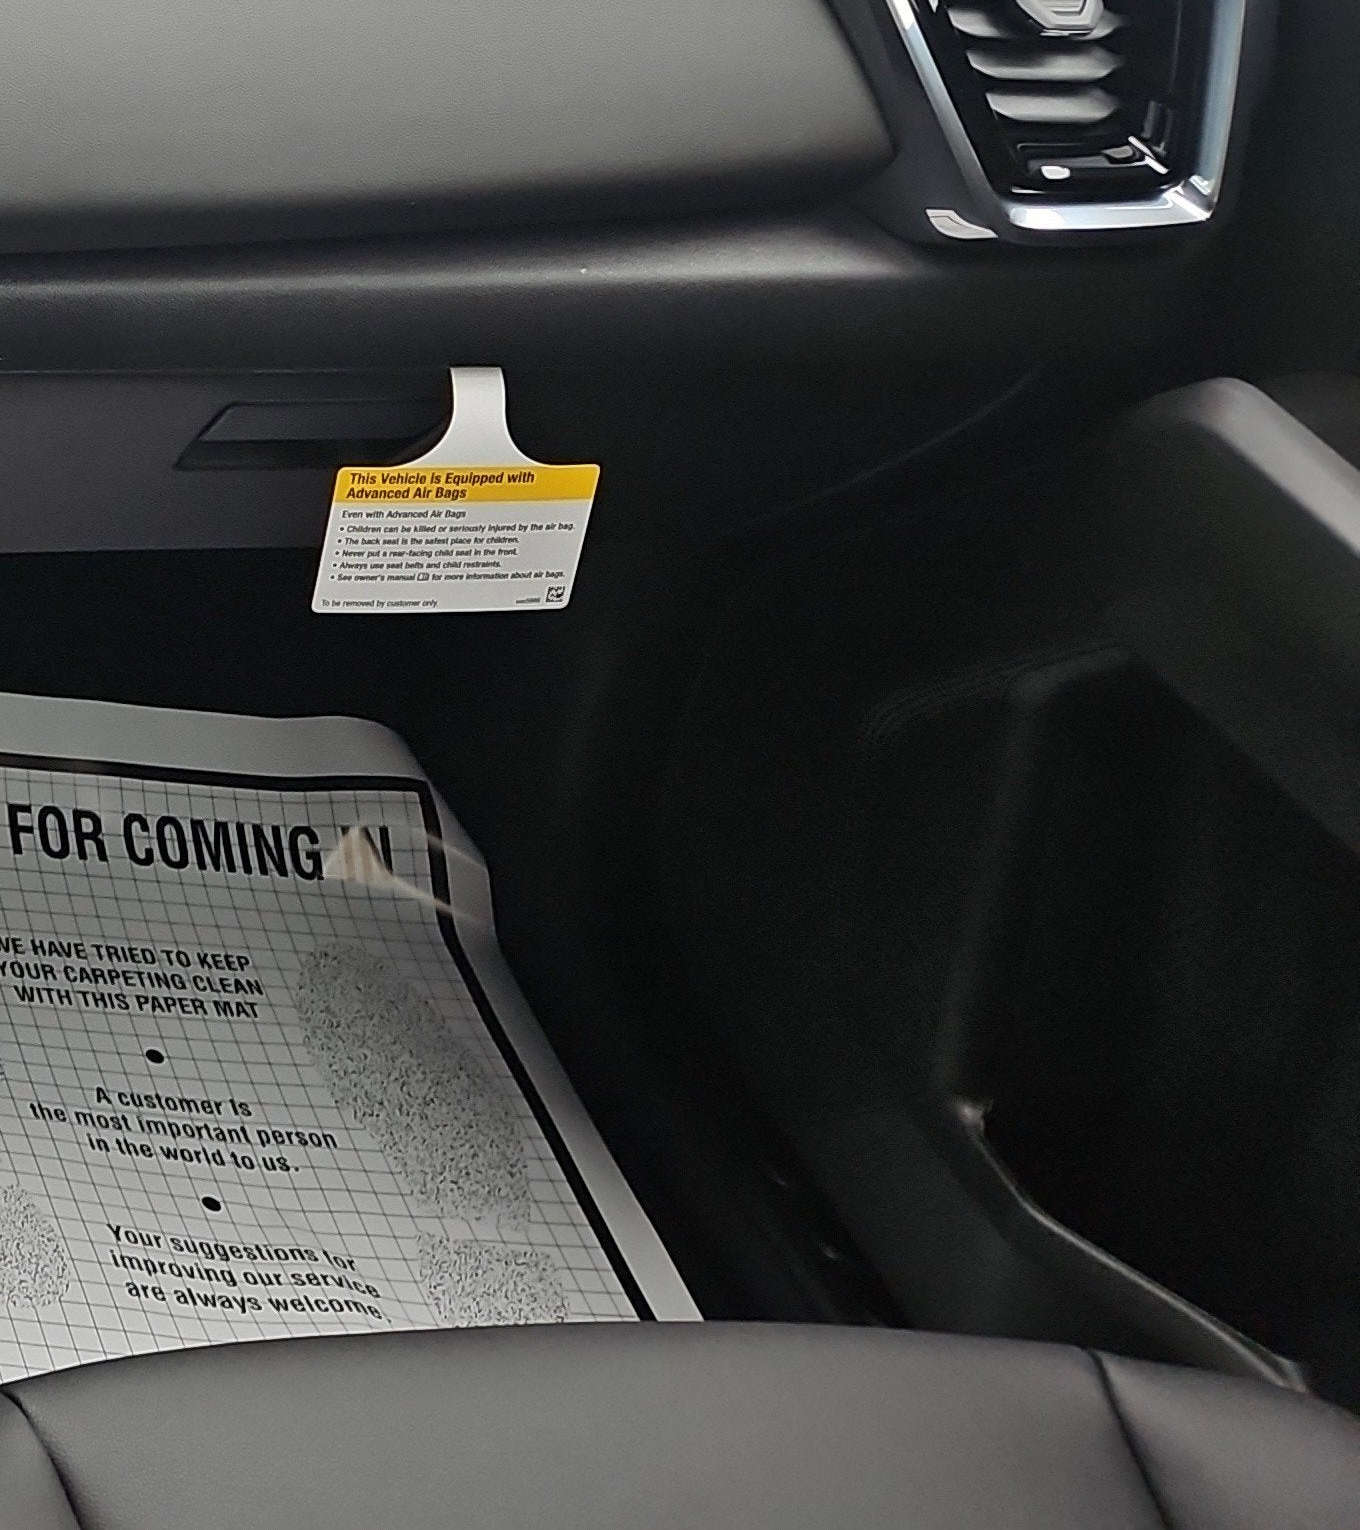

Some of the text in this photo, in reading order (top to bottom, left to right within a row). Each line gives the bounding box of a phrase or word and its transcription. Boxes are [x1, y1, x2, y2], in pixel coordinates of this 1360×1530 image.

[346, 486, 467, 501] Advanced Air Bags
[350, 472, 376, 484] This
[381, 472, 426, 485] Vehicle
[445, 472, 504, 487] Equipped
[508, 471, 534, 483] with
[342, 510, 466, 520] Even with Advanced Air Bags
[347, 525, 381, 533] Children
[401, 525, 411, 533] be
[414, 525, 436, 533] killed
[449, 525, 485, 533] seriously
[488, 524, 516, 533] injured
[519, 524, 528, 532] by
[531, 523, 543, 531] the
[345, 537, 359, 545] The
[361, 537, 380, 545] back
[383, 537, 399, 545] seat
[425, 537, 449, 545] safest
[450, 537, 471, 545] place
[7, 802, 109, 862] FOR
[122, 812, 324, 880] COMING
[30, 940, 88, 960] HAVE
[91, 944, 156, 965] TRIED
[161, 950, 191, 968] TO
[197, 951, 250, 972] KEEP
[64, 965, 187, 991] CARPETING
[193, 975, 264, 996] CLEAN
[13, 985, 259, 1019] WITH THIS PAPER MAT
[95, 1086, 253, 1118] A customer is
[30, 1102, 338, 1149] the most important person
[86, 1133, 300, 1173] in the world to us.
[106, 1223, 356, 1272] Your suggestions for
[109, 1249, 381, 1299] improving our service
[125, 1280, 392, 1324] are always welcome.
